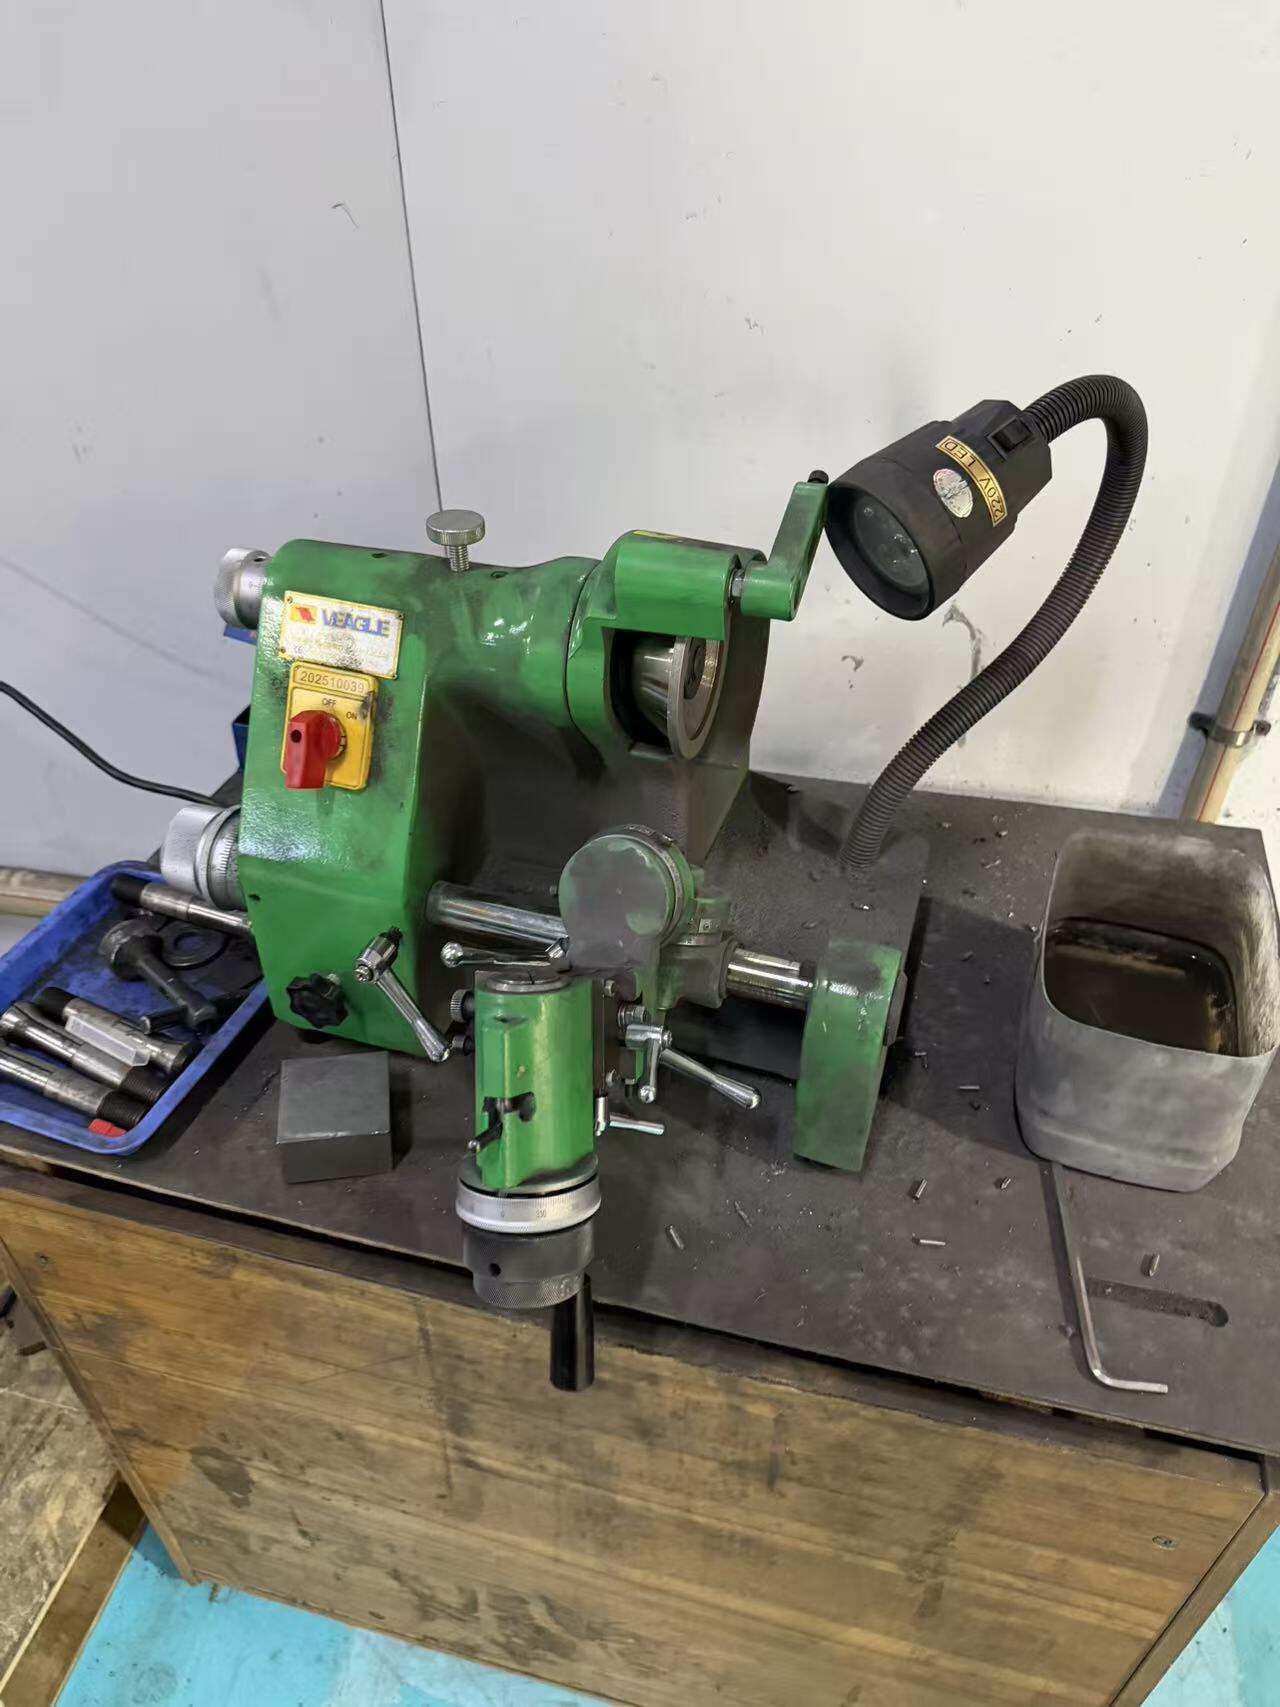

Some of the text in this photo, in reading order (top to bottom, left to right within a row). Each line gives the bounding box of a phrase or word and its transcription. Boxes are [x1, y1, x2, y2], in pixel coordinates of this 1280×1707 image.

[944, 441, 976, 467] LED
[979, 478, 1003, 517] 220V
[301, 671, 364, 693] 202510039
[321, 698, 337, 708] OFF
[346, 711, 357, 720] ON
